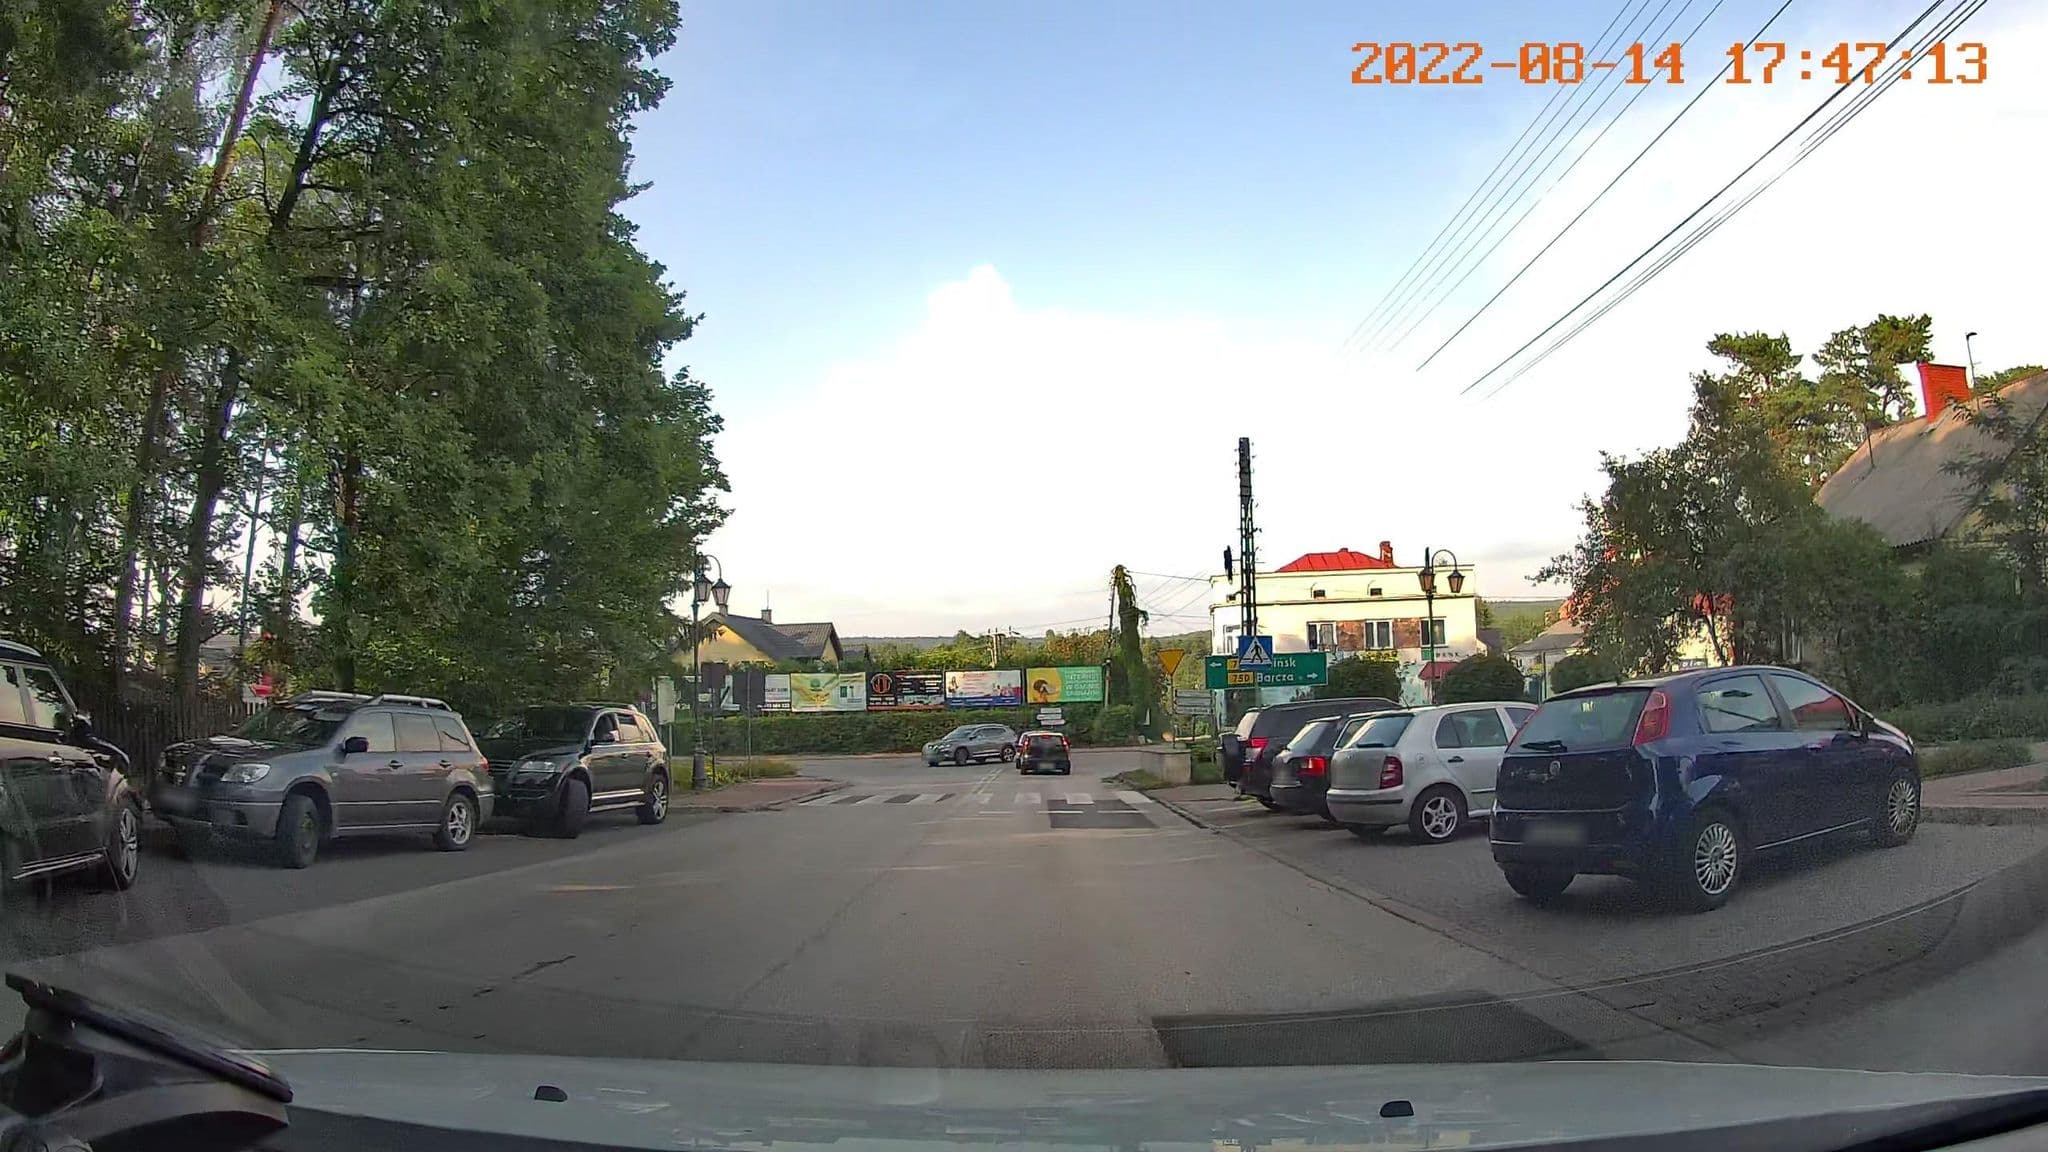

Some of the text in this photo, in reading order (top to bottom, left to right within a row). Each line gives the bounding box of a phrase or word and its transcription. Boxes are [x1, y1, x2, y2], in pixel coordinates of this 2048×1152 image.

[1273, 656, 1296, 668] ińsk
[1230, 672, 1294, 683] 750 Barcza
